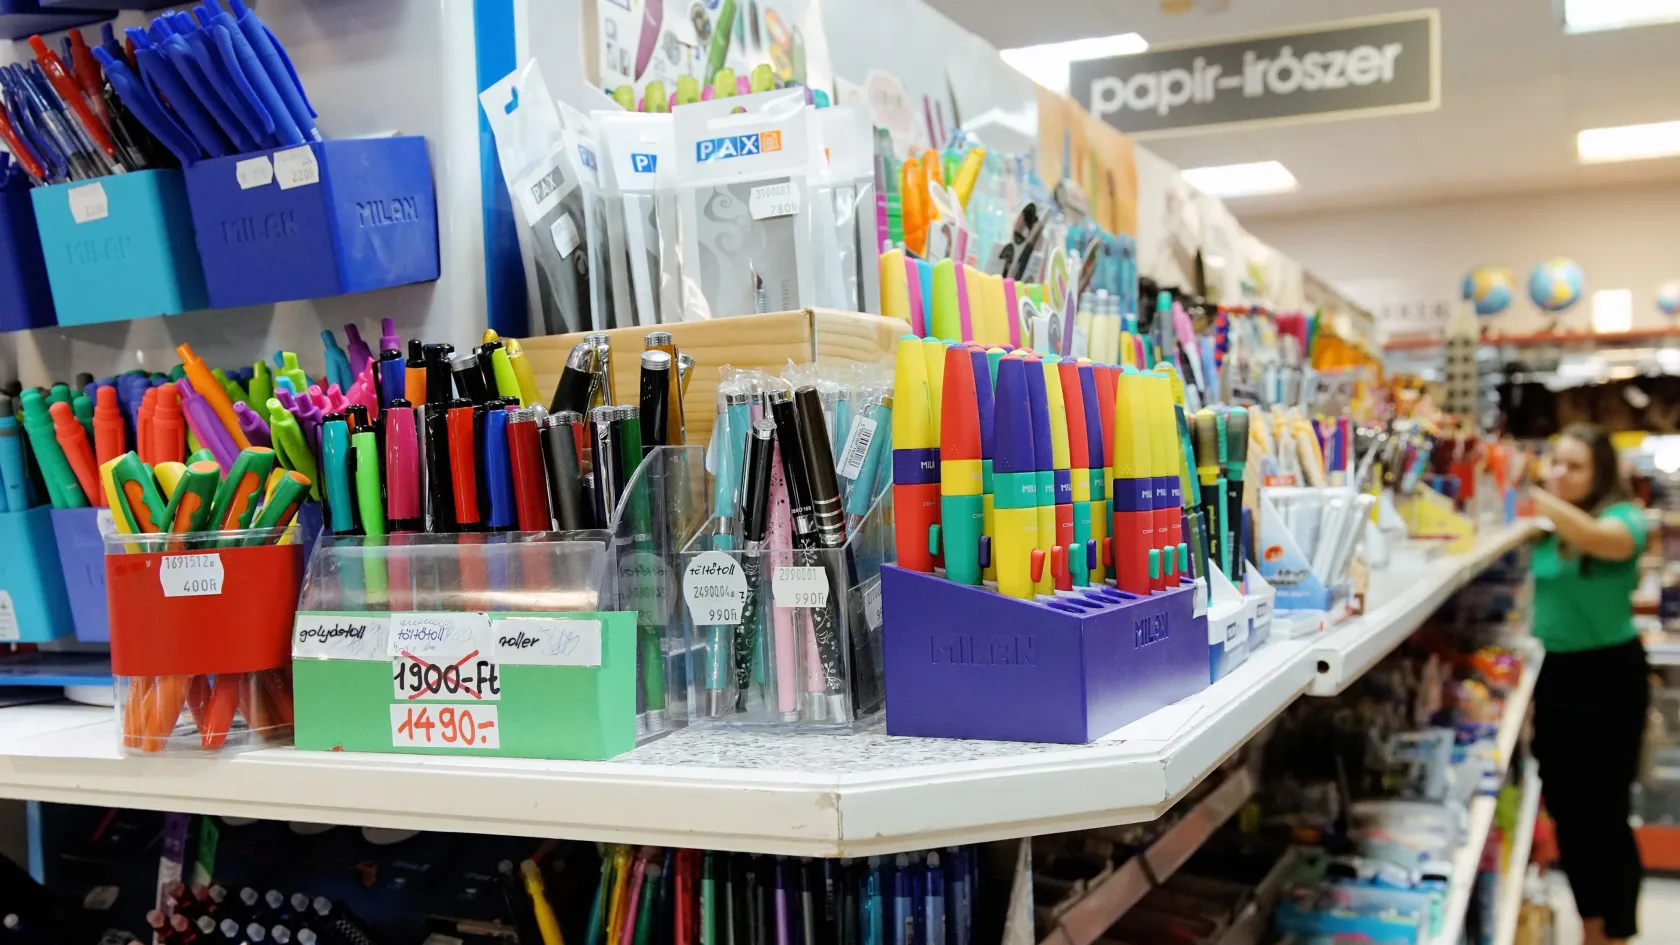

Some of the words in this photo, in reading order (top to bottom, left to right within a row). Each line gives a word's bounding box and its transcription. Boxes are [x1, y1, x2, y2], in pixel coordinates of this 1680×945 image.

[699, 135, 759, 160] PAX
[531, 173, 558, 203] PAX
[221, 210, 299, 245] MILAN
[356, 196, 419, 228] MILAN
[499, 631, 540, 649] roller
[1134, 611, 1169, 650] MILAN
[930, 633, 1037, 667] MILAN
